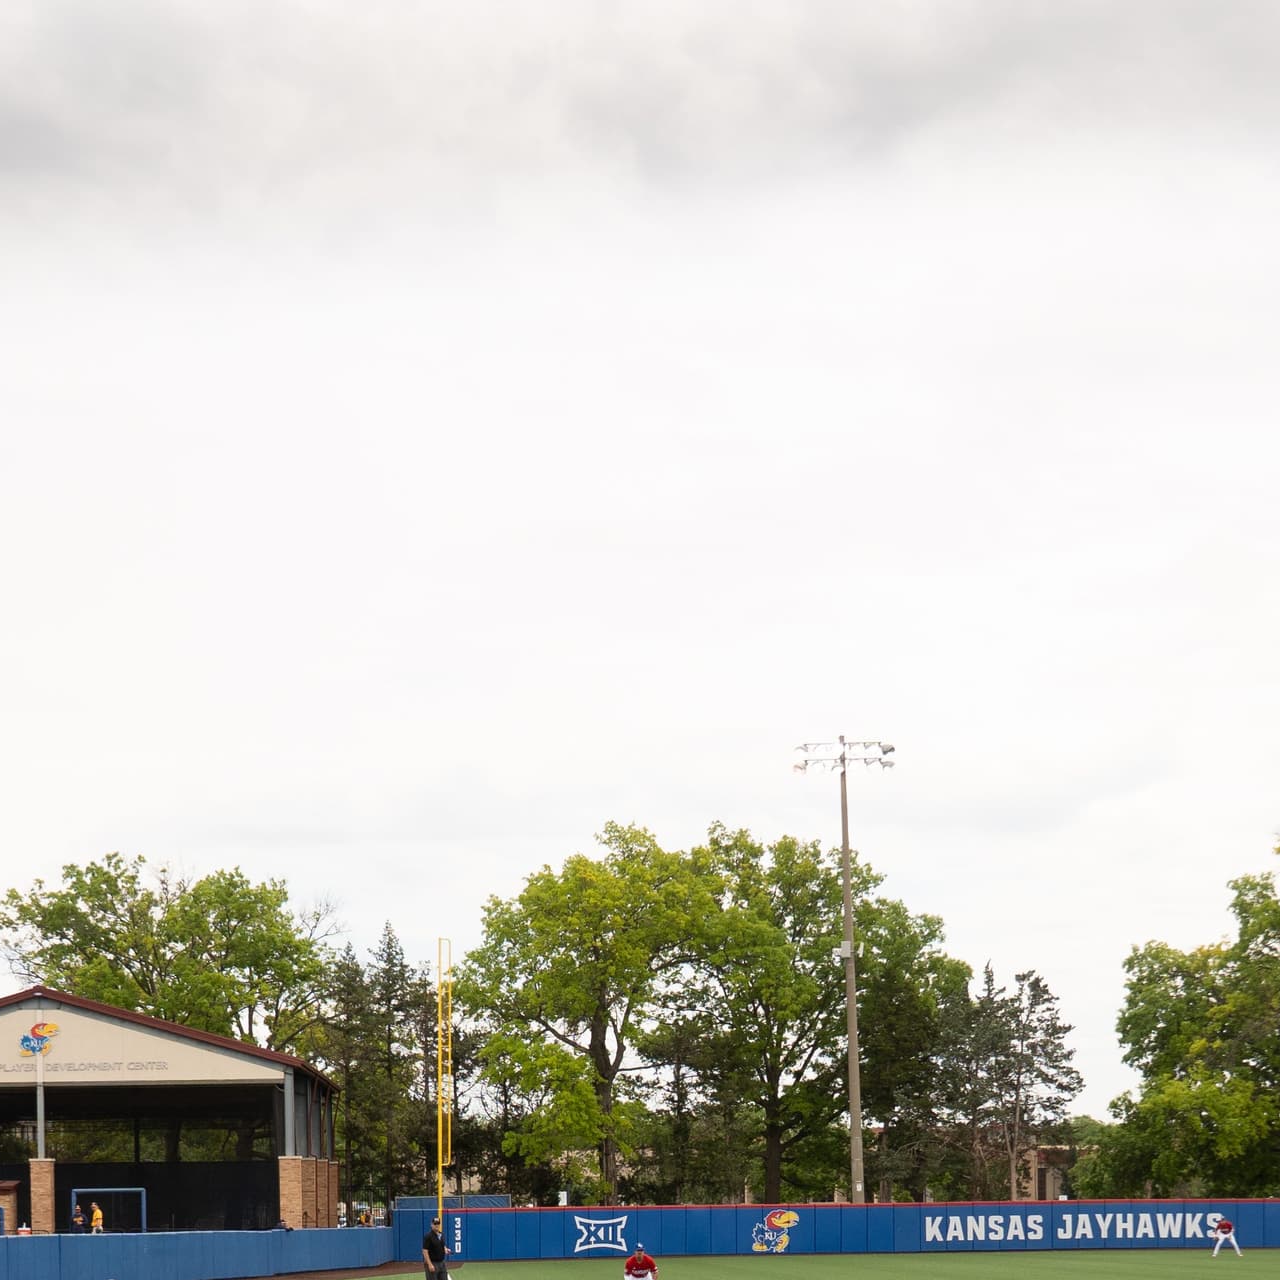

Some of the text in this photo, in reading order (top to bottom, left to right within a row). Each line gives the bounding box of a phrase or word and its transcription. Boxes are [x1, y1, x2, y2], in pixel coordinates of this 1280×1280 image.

[45, 1062, 123, 1072] DEVELOPMENT
[127, 1061, 169, 1071] CENTER
[454, 1217, 462, 1254] 330
[765, 1232, 777, 1240] KU
[925, 1212, 1225, 1242] KANSAS JAYHAWKS
